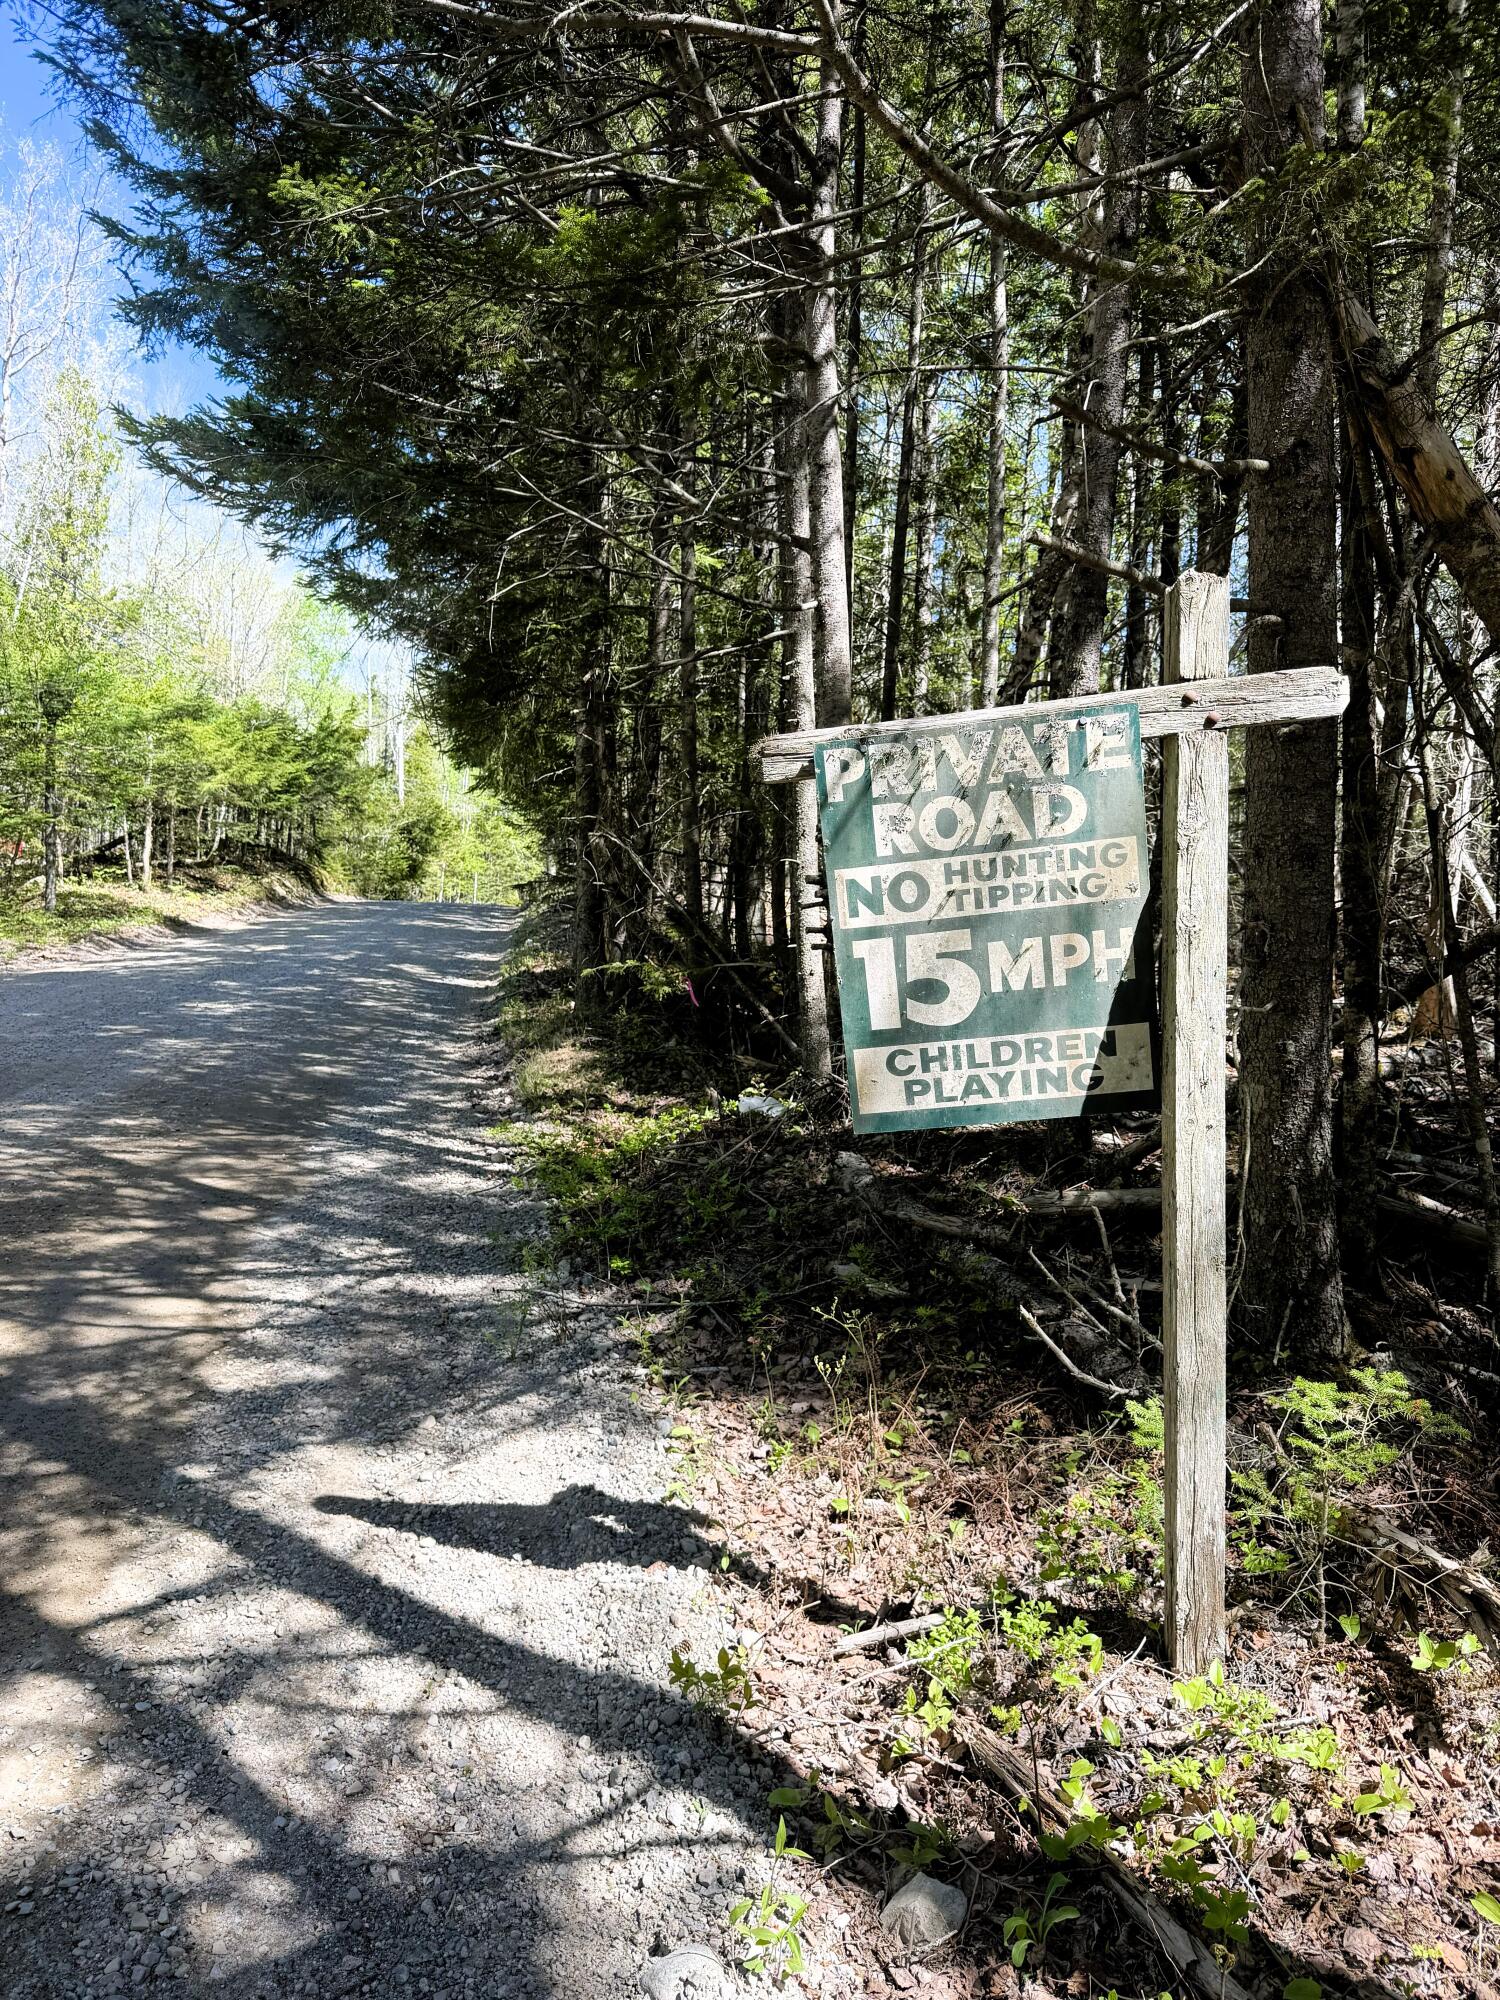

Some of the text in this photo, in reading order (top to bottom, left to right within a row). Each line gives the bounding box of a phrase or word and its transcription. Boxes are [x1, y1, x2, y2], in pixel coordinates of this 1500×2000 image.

[823, 713, 1132, 802] PRIVATE
[873, 784, 1087, 857] ROAD
[845, 842, 1129, 918] NO HUNTING
[947, 872, 1107, 912] TIPPING
[852, 927, 1136, 1030] 15 MPH
[885, 1030, 1117, 1077] CHILDREN
[904, 1062, 1105, 1106] PLAYING
